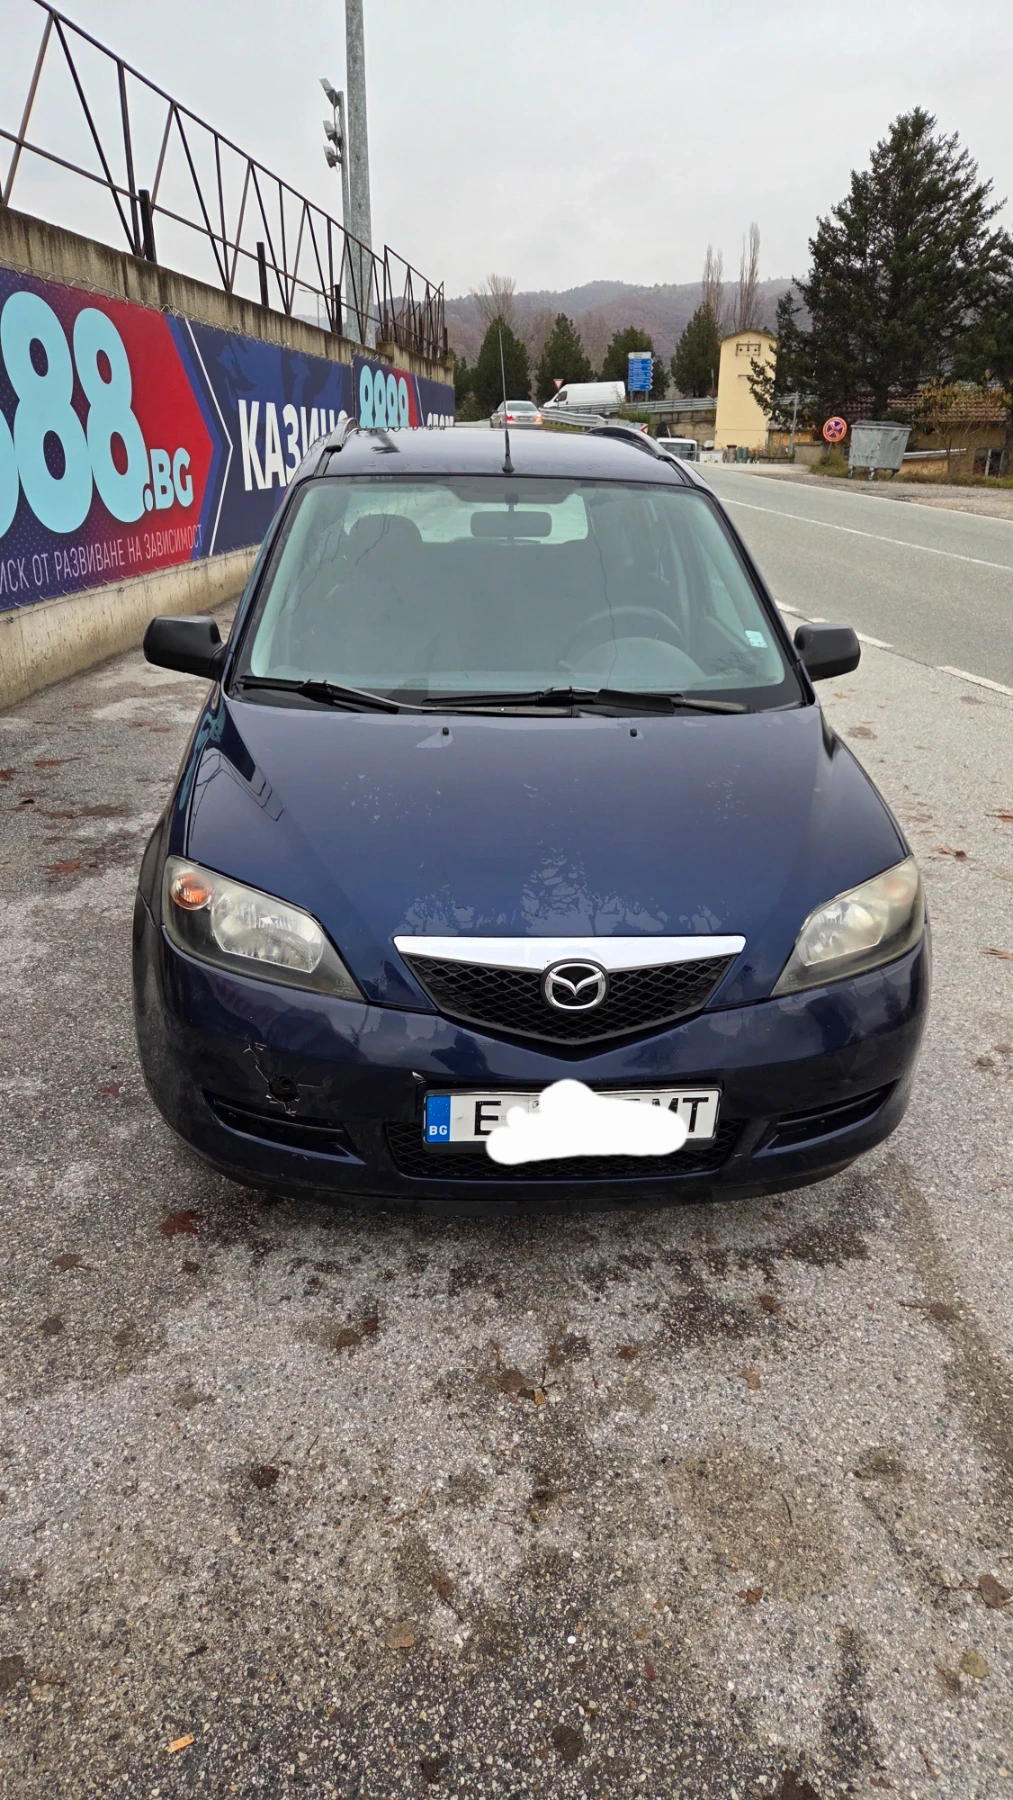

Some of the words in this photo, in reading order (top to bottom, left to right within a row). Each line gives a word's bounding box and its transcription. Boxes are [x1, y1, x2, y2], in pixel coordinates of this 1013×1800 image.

[0, 291, 194, 540] 88.BG
[238, 399, 348, 491] КАЗИ
[32, 553, 50, 586] ОТ
[54, 539, 125, 581] РАЗВИВАНЕ
[128, 536, 143, 563] НА
[143, 524, 203, 558] ЗАВИСИМОСТ
[429, 1125, 448, 1136] BG
